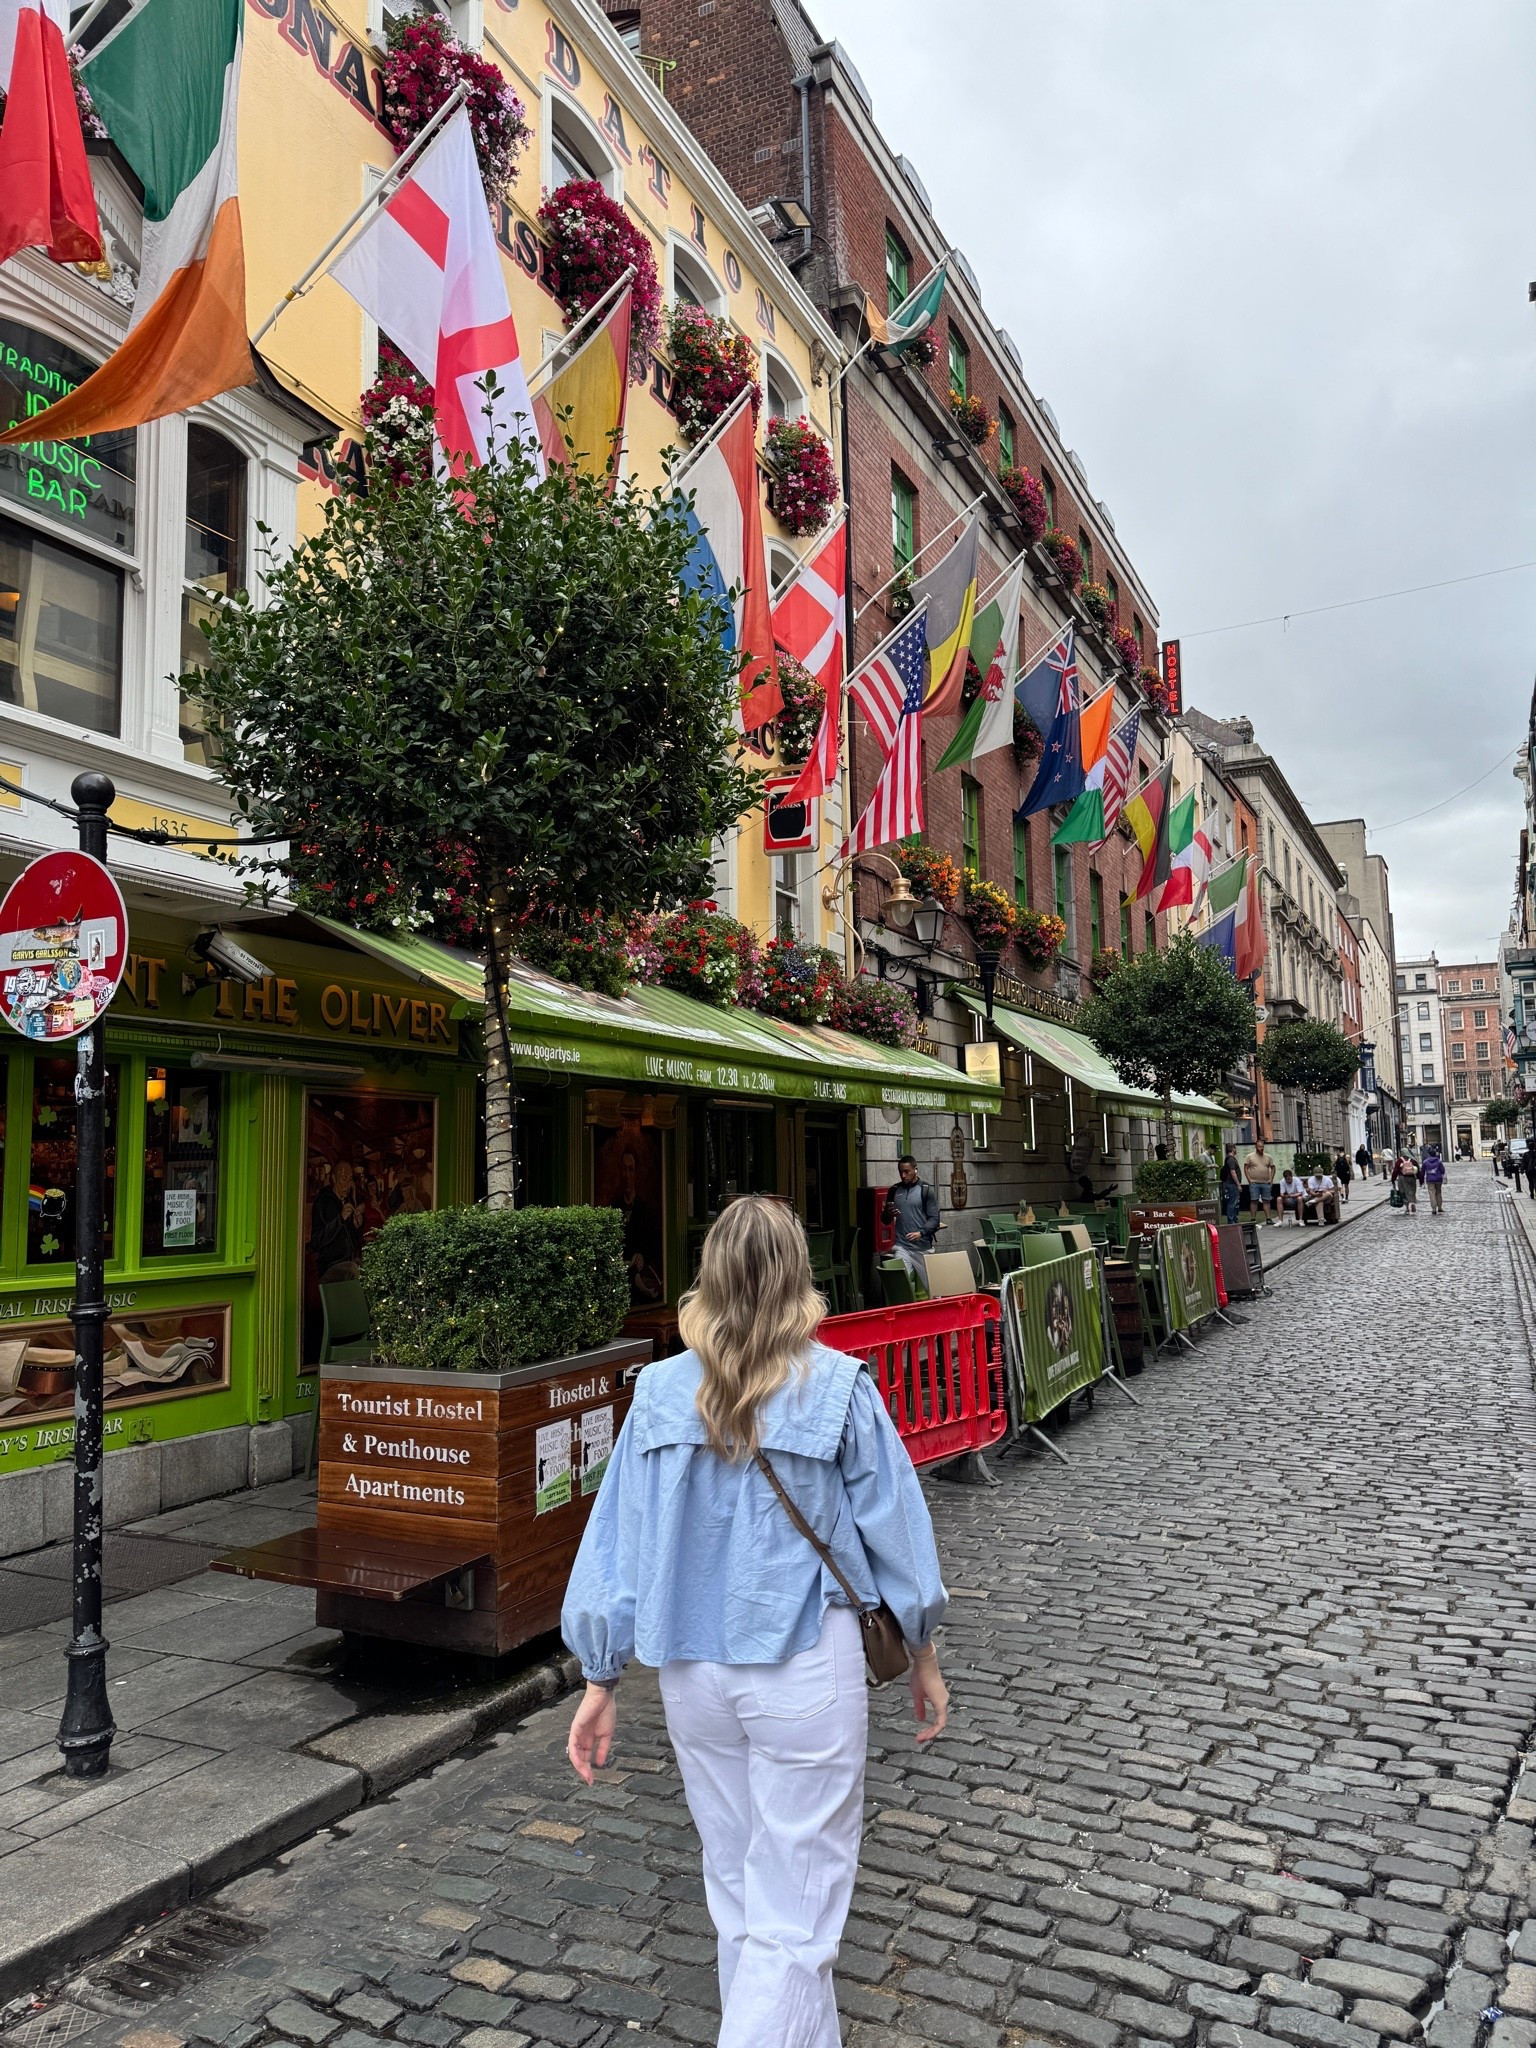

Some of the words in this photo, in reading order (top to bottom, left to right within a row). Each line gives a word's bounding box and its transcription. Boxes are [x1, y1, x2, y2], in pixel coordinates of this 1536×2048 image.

[28, 467, 89, 520] BAR
[1166, 644, 1179, 714] HOSTEL
[152, 816, 189, 838] 1835
[320, 983, 452, 1045] OLIVER
[645, 1055, 665, 1078] LIVE
[666, 1058, 693, 1082] MUSIC
[696, 1069, 712, 1084] FROM
[716, 1066, 739, 1087] 12.30
[166, 1200, 185, 1209] MUSIC
[1152, 1210, 1168, 1218] Bar
[1168, 1210, 1176, 1218] &
[549, 1377, 596, 1409] Hostel
[598, 1376, 610, 1394] &
[338, 1393, 411, 1417] Tourist
[415, 1397, 483, 1422] Hostel
[583, 1414, 594, 1427] LIVE
[583, 1425, 603, 1440] MUSIC
[0, 1434, 28, 1455] Y'S
[103, 1417, 123, 1435] AR
[342, 1432, 358, 1454] &
[363, 1434, 471, 1465] Penthouse
[538, 1430, 550, 1443] LIVE
[539, 1439, 559, 1455] MUSIC
[593, 1446, 609, 1461] FOOD
[549, 1462, 566, 1477] FOOD
[344, 1472, 465, 1507] Apartments
